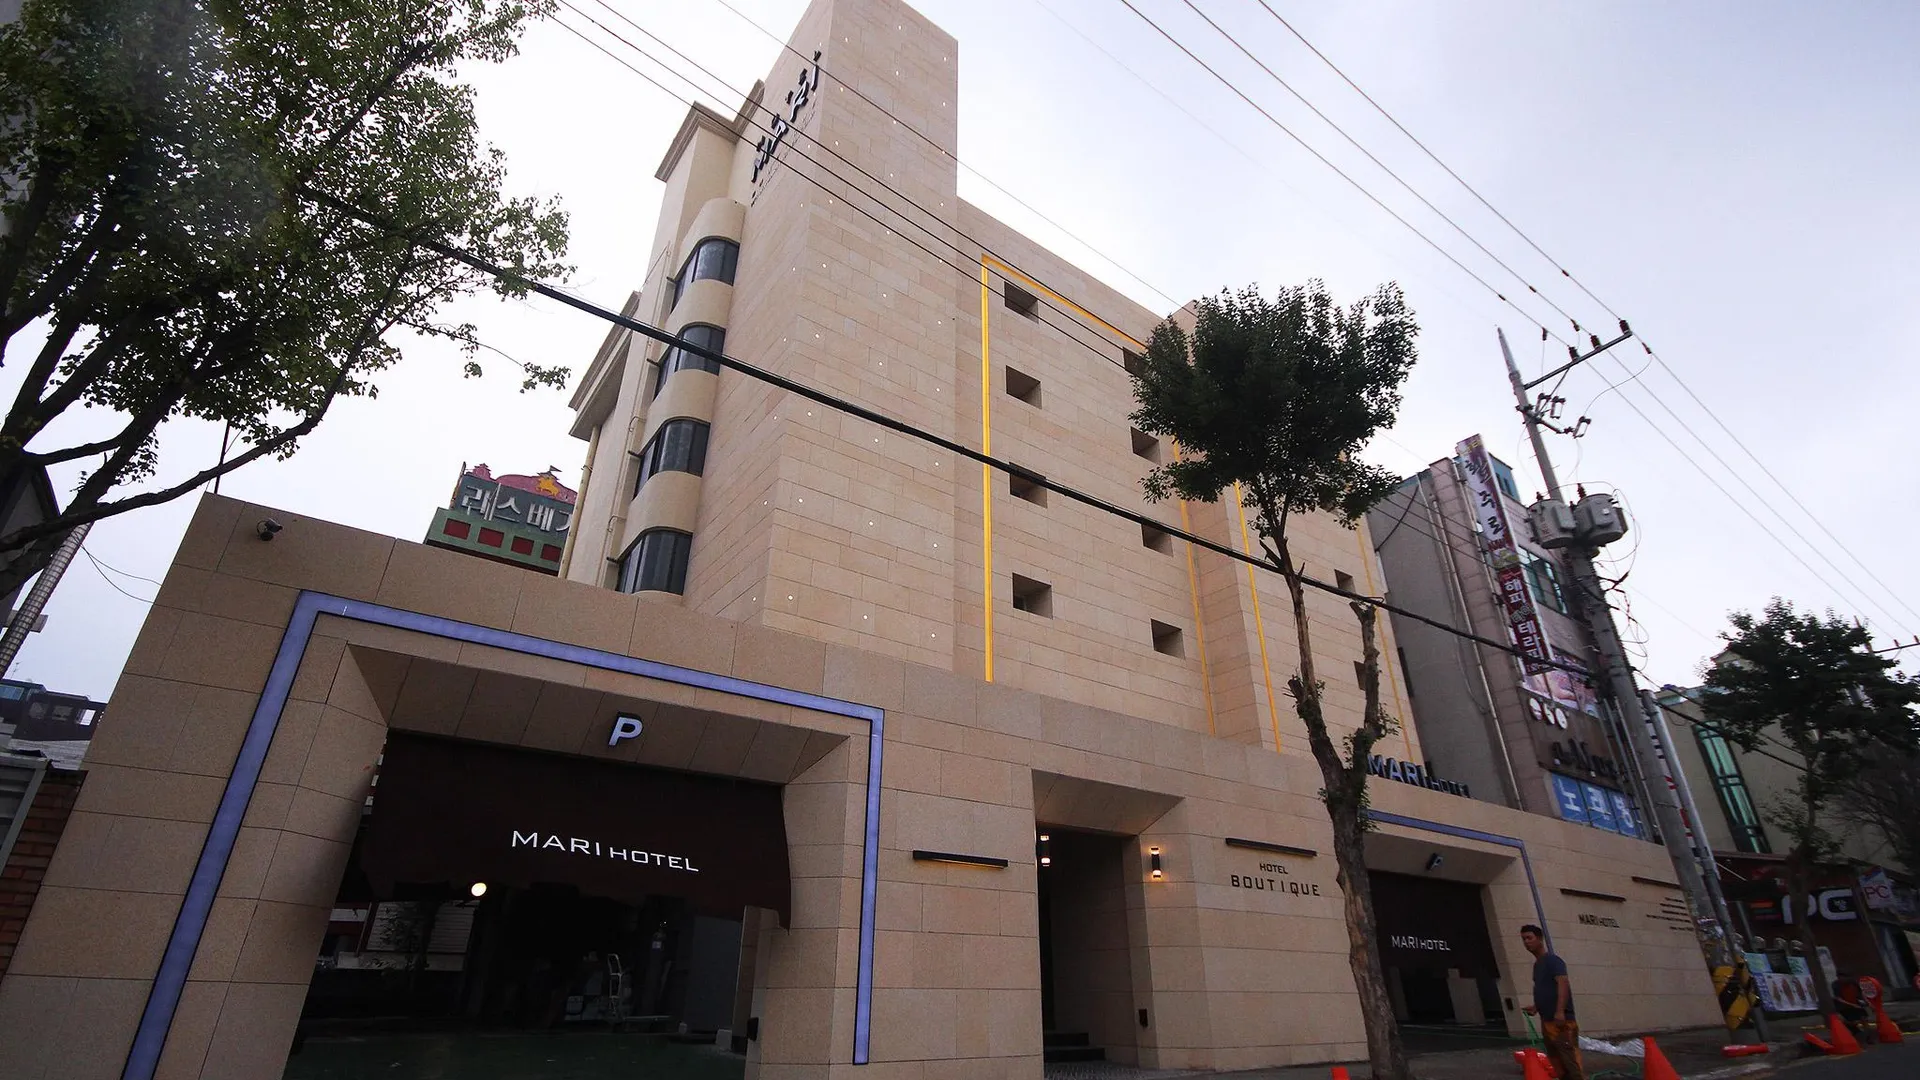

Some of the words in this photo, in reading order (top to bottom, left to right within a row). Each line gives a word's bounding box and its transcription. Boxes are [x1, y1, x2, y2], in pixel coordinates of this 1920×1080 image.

[751, 63, 820, 184] MARI
[608, 712, 644, 746] P
[1366, 754, 1430, 789] MARI
[511, 830, 601, 857] MARI
[609, 846, 699, 873] HOTEL
[1427, 853, 1443, 870] P
[1259, 862, 1289, 875] HOTEL
[1230, 874, 1321, 898] BOUTIQUE
[1864, 885, 1890, 900] PC
[1578, 914, 1599, 927] MARI
[1600, 916, 1621, 929] HOTEL
[1391, 935, 1420, 950] MARI
[1420, 938, 1451, 951] HOTEL
